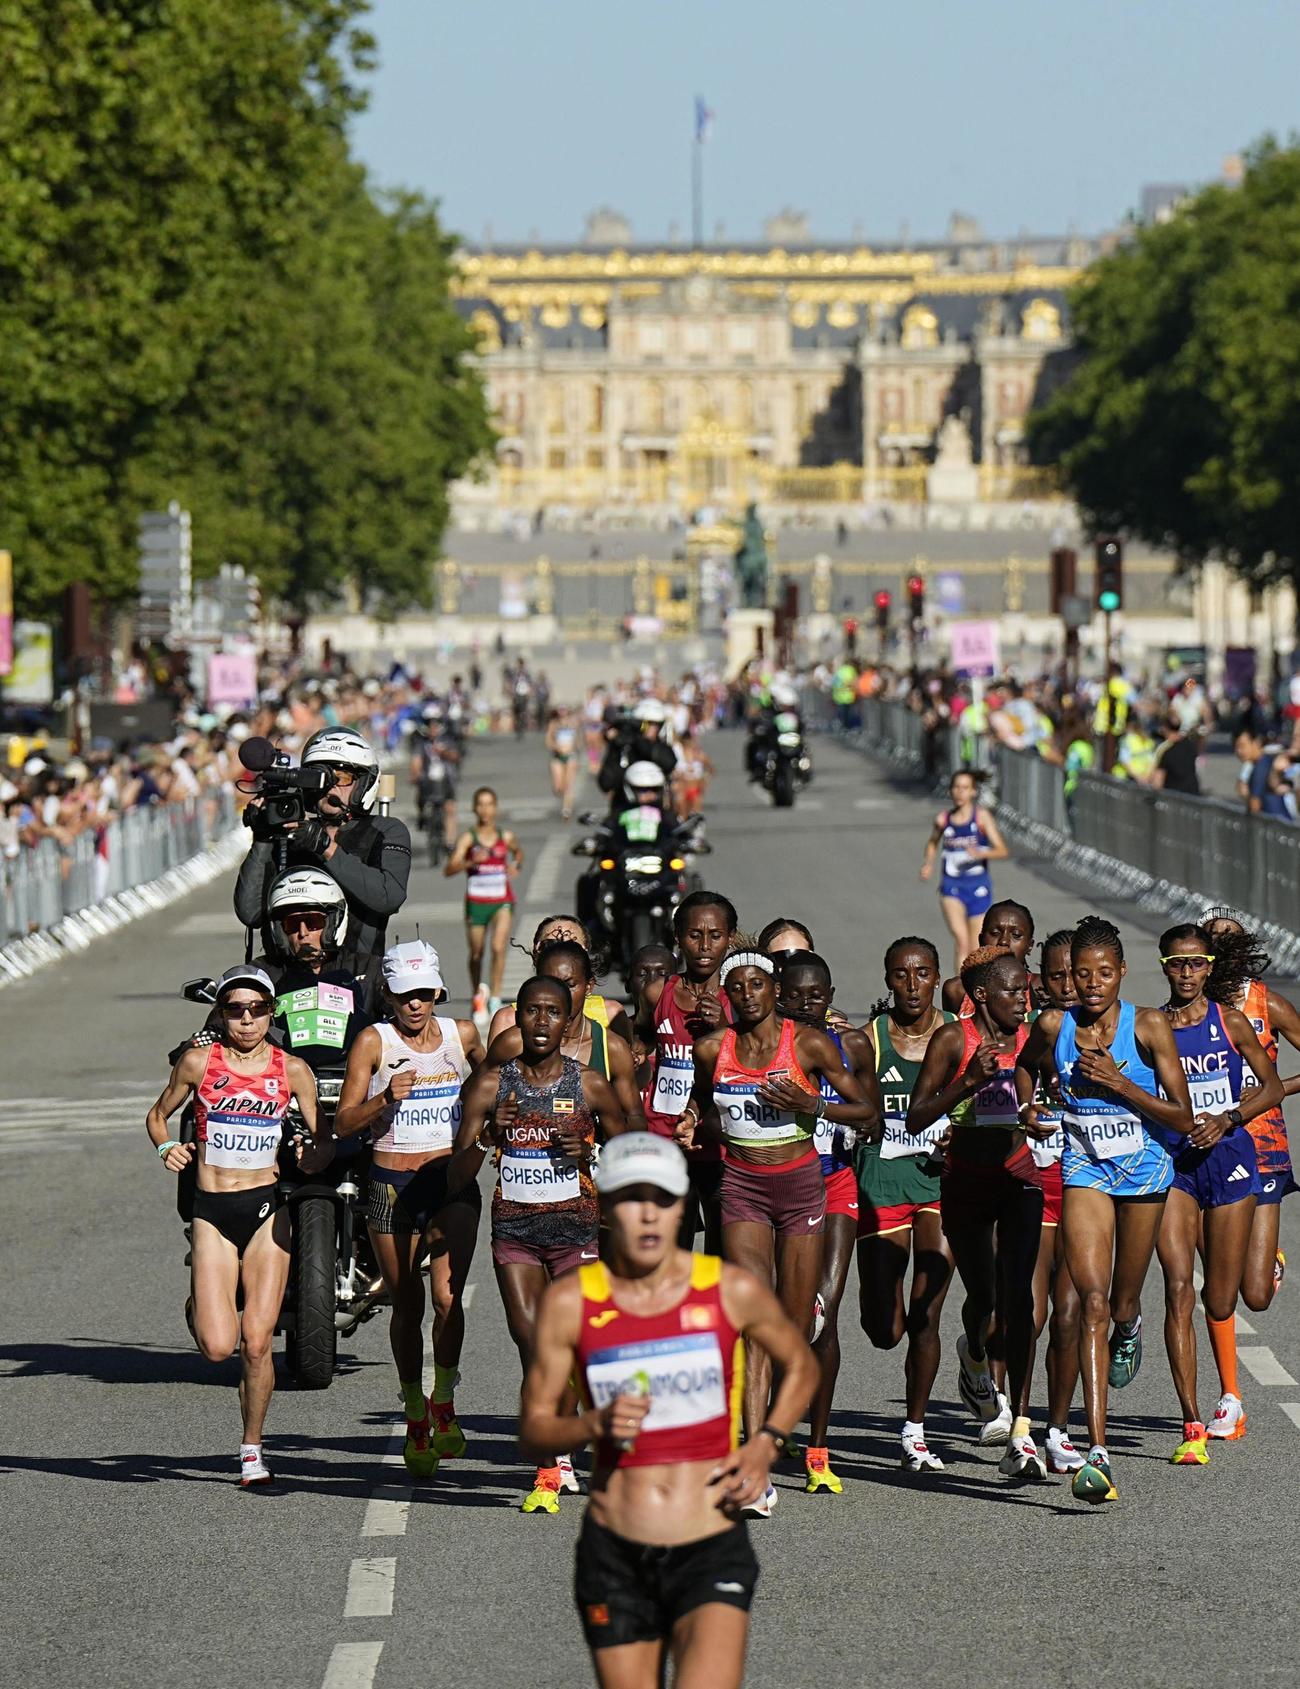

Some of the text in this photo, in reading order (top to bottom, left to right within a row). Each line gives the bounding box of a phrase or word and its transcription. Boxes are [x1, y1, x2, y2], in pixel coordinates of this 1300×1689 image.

[435, 1089, 452, 1097] 2024
[211, 1096, 279, 1117] JAPAN
[727, 1104, 780, 1121] OBIRI
[226, 1116, 267, 1126] PARIS 2024
[213, 1132, 275, 1152] SUZUKI
